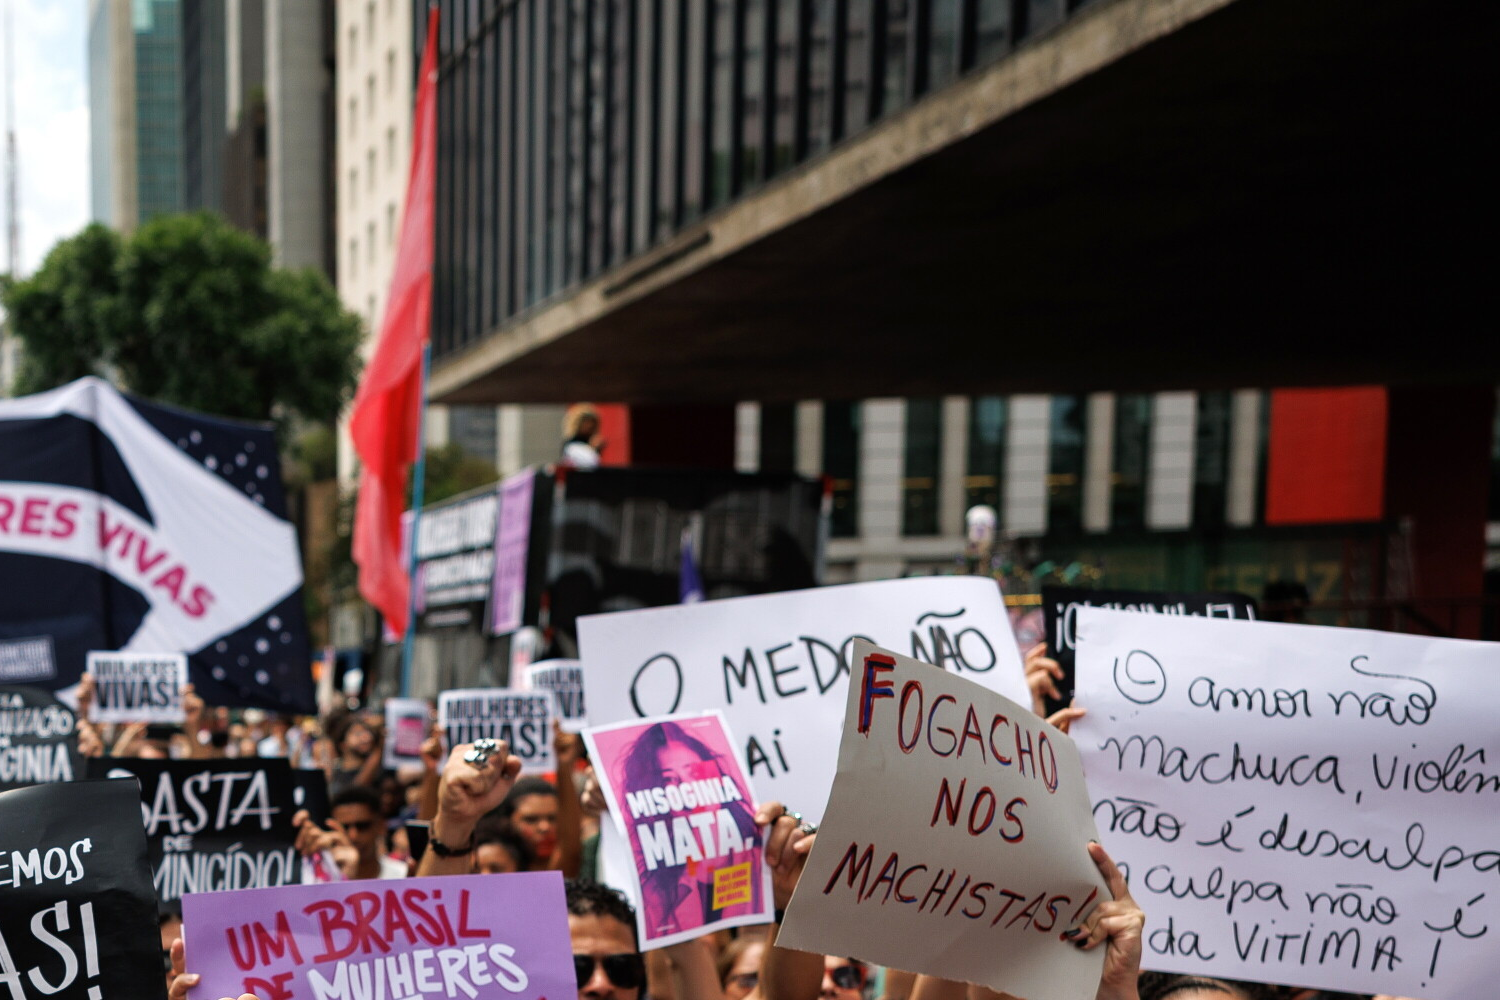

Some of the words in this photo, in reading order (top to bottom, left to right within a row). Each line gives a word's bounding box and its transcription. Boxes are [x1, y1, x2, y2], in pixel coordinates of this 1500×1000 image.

[97, 508, 215, 619] VIVAS
[95, 679, 179, 709] VIVAS!
[630, 652, 684, 718] O
[1188, 676, 1312, 718] amor
[1328, 655, 1437, 726] não
[858, 653, 1059, 793] FOGACHO
[112, 768, 281, 836] ASTA
[626, 775, 743, 820] MISOGINIA
[930, 777, 1028, 845] NOS
[163, 834, 193, 852] DE
[637, 808, 755, 872] MATA.
[1196, 805, 1255, 853] é
[1259, 813, 1500, 883] desculpa
[1144, 865, 1290, 915] culpa
[1305, 883, 1400, 926] não
[1423, 892, 1489, 939] é
[225, 910, 304, 971] UM
[1148, 915, 1217, 962] da
